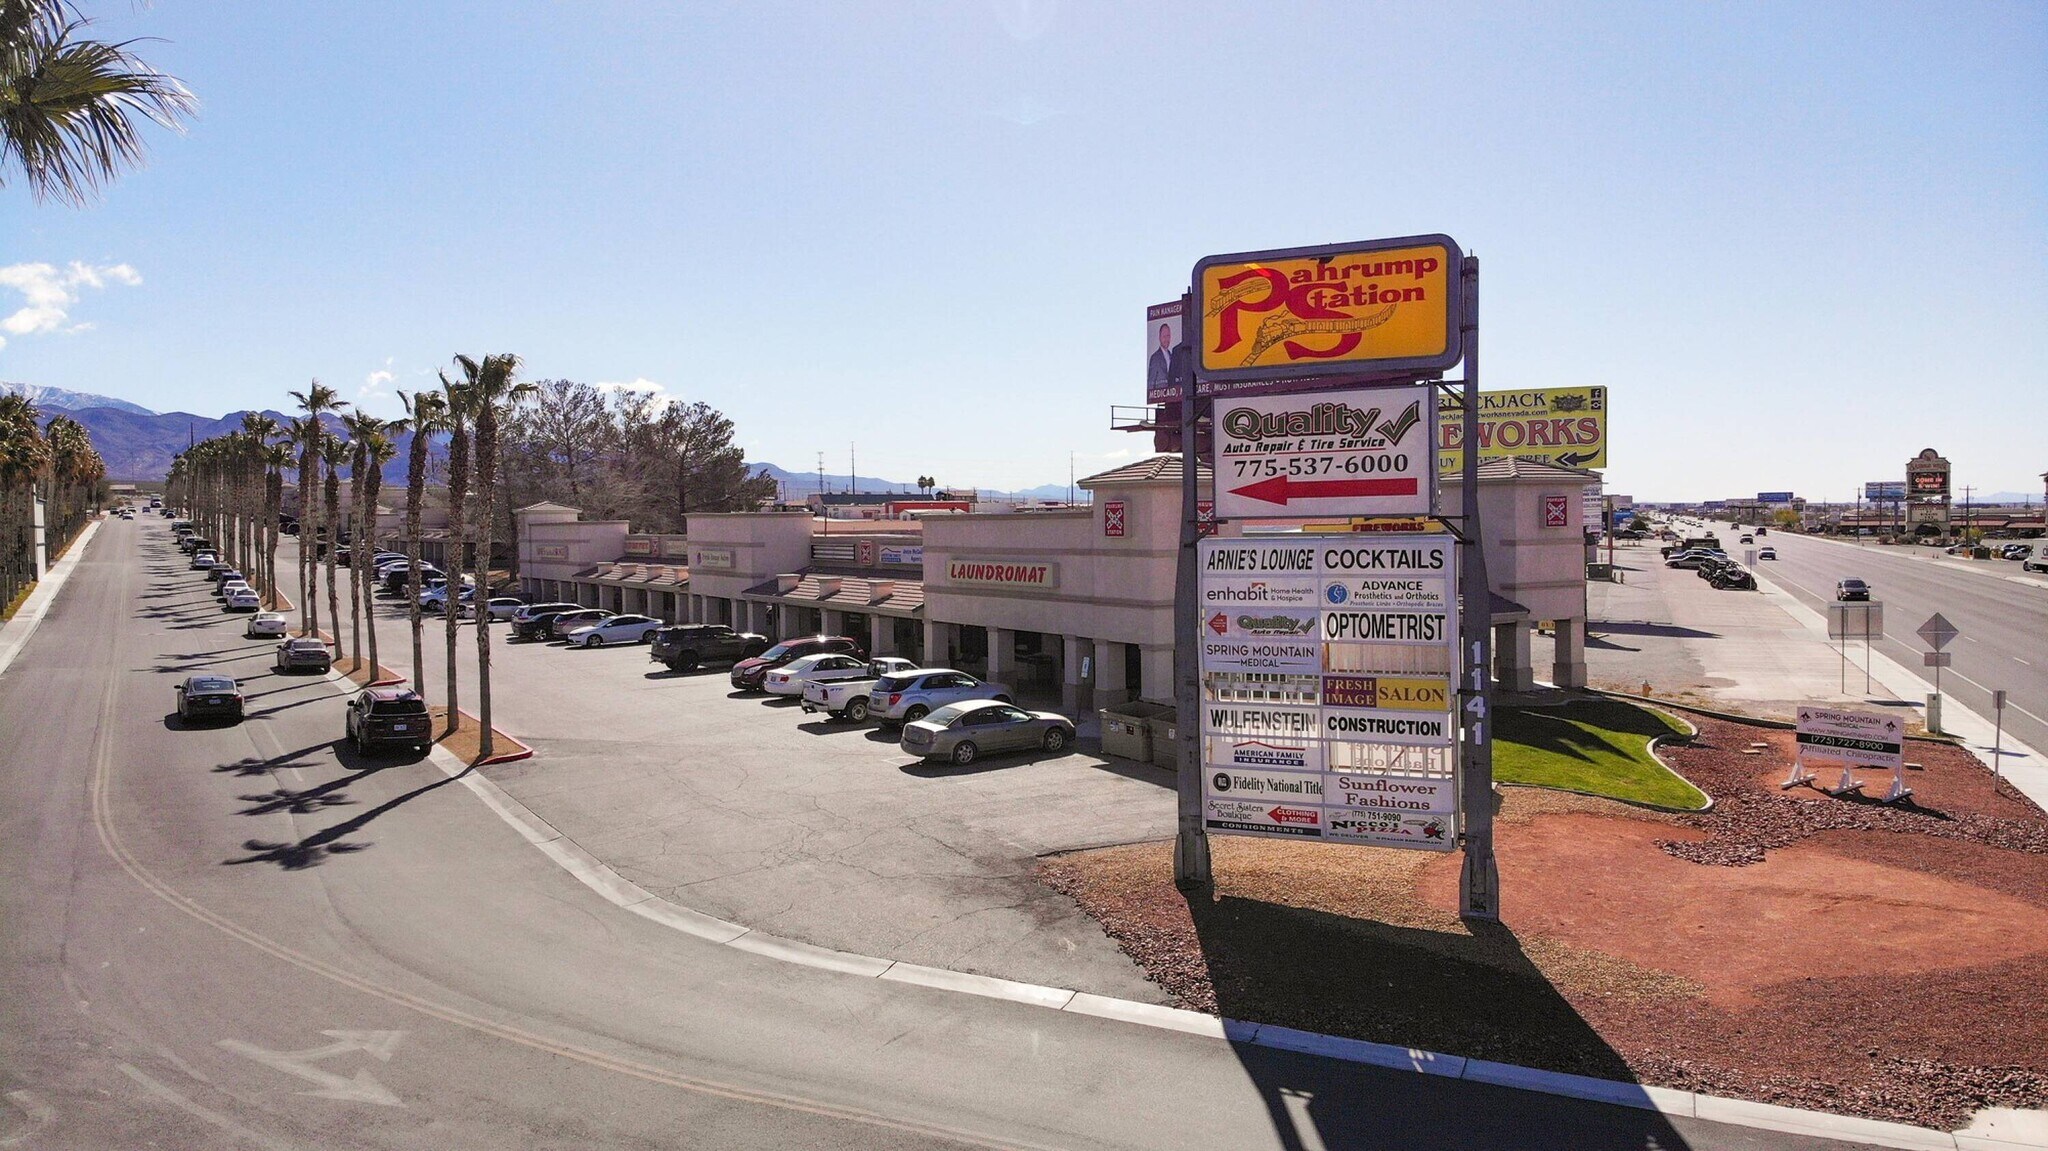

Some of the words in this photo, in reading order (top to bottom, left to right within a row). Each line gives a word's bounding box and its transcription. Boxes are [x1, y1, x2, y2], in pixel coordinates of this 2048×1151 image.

[1222, 403, 1381, 441] Quality
[1224, 442, 1250, 453] Auto
[1255, 440, 1293, 454] Repair
[1311, 439, 1334, 449] Tire
[1339, 436, 1386, 448] Service
[1234, 454, 1408, 478] 775-537-6000
[1352, 522, 1425, 532] FIREWORKS
[1207, 549, 1257, 570] ARNIE'S
[1261, 549, 1314, 570] LOUNGE
[1325, 549, 1444, 569] COCKTAILS
[951, 563, 1047, 584] LAUNDROMAT
[1362, 581, 1423, 591] ADVANCE
[1207, 587, 1268, 601] enhabit
[1354, 591, 1392, 600] Prosthetics
[1405, 591, 1439, 601] Orthotics
[1237, 615, 1301, 631] Quality
[1326, 612, 1445, 641] OPTOMETRIST
[1206, 644, 1249, 656] SPRING
[1253, 646, 1315, 657] MOUNTAIN
[1240, 658, 1279, 667] MEDICAL
[1327, 679, 1373, 691] FRESH
[1326, 693, 1375, 706] IMAGE
[1379, 686, 1444, 703] SALON
[1210, 709, 1316, 732] WULFENSTEIN
[1815, 712, 1841, 721] SPRING
[1843, 714, 1880, 725] MOUNTAIN
[1328, 716, 1441, 736] CONSTRUCTION
[1811, 735, 1835, 745] (775)
[1838, 737, 1884, 751] 727-8900
[1239, 757, 1299, 765] INSURANCE
[1276, 751, 1304, 759] FAMILY
[1845, 749, 1896, 762] Chiropractic
[1233, 776, 1265, 794] Fidelity
[1267, 778, 1302, 793] National
[1339, 777, 1437, 795] Sunflower
[1208, 800, 1235, 811] Secret
[1236, 802, 1264, 813] Sisters
[1345, 793, 1430, 810] Fashions
[1217, 810, 1252, 821] Boutique
[1277, 809, 1316, 817] CLOTHING
[1352, 810, 1366, 818] (775)
[1368, 811, 1401, 821] 751-9090
[1222, 822, 1304, 834] CONSIGNMENTS
[1356, 827, 1413, 835] PIZZA
